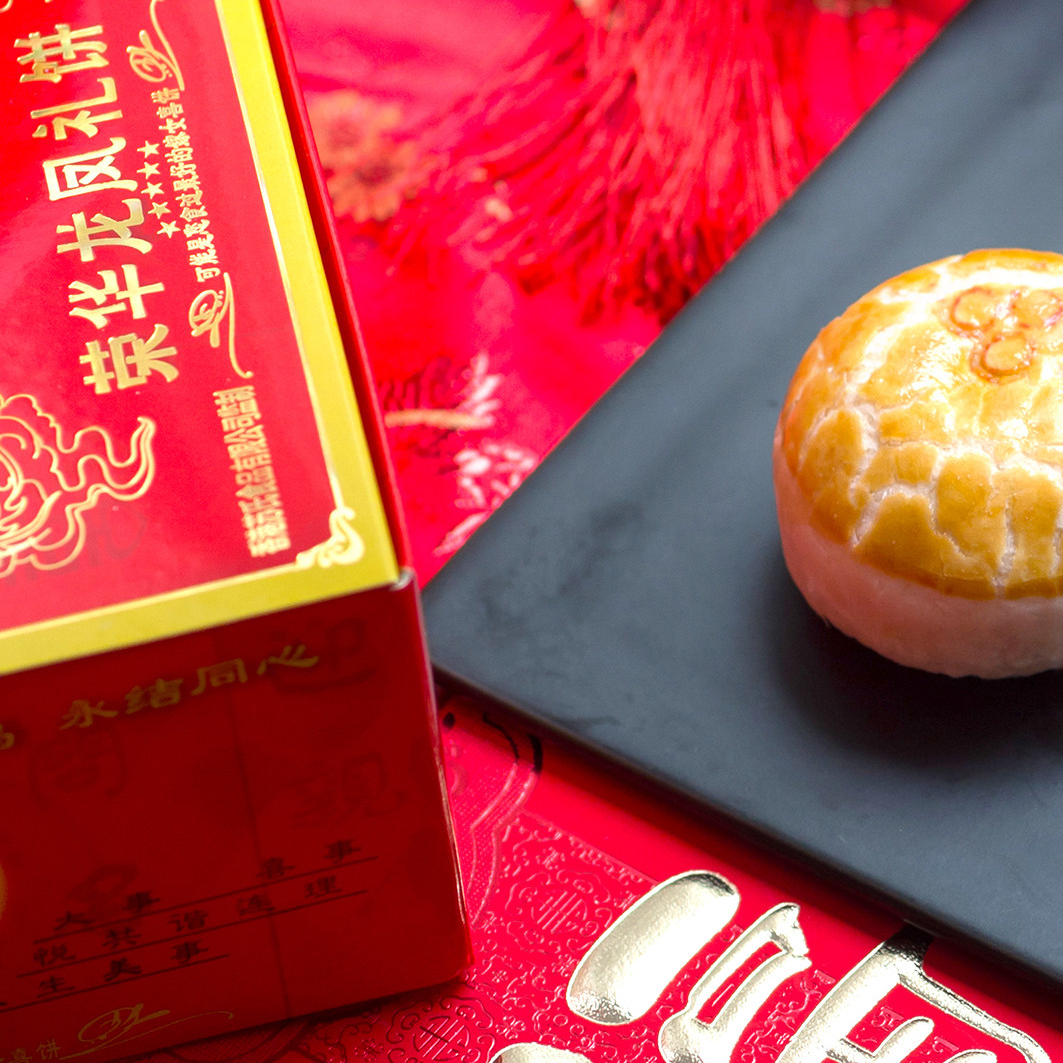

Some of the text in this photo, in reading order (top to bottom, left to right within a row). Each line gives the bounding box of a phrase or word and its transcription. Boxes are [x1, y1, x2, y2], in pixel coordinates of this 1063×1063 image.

[14, 23, 180, 394] 荣华龙凤礼饼
[58, 645, 319, 730] 永结同心
